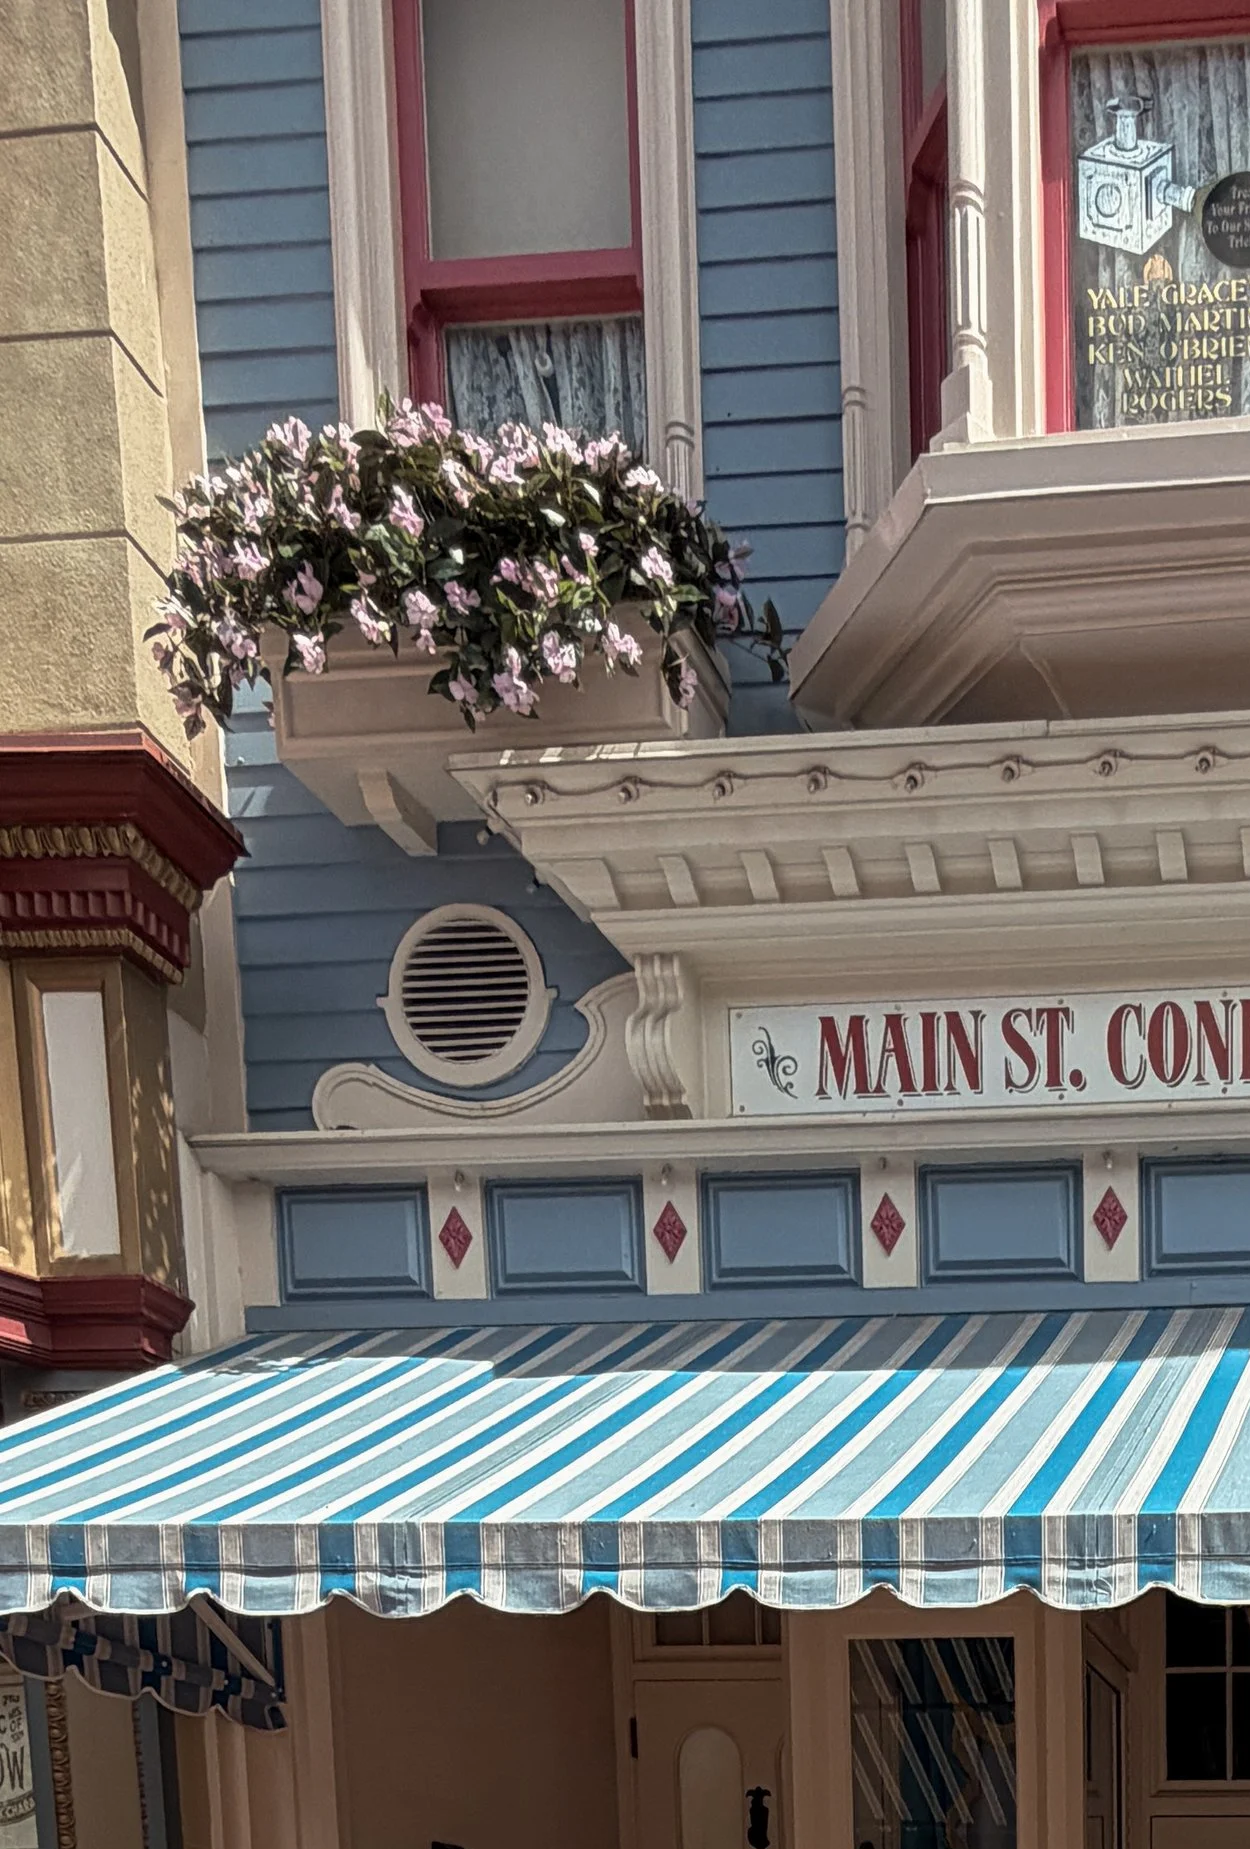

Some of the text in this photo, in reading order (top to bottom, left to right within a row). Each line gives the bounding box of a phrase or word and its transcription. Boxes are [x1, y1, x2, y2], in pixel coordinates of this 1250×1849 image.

[1211, 202, 1236, 217] Your
[1206, 220, 1219, 234] To
[1221, 220, 1241, 233] Our
[1087, 284, 1150, 310] YALE
[1088, 313, 1147, 338] BUD
[1088, 342, 1144, 365] KEN
[1123, 363, 1231, 388] WATHEL
[1121, 388, 1233, 414] ROGERS
[815, 1009, 988, 1100] MAIN
[1001, 1006, 1087, 1094] ST.
